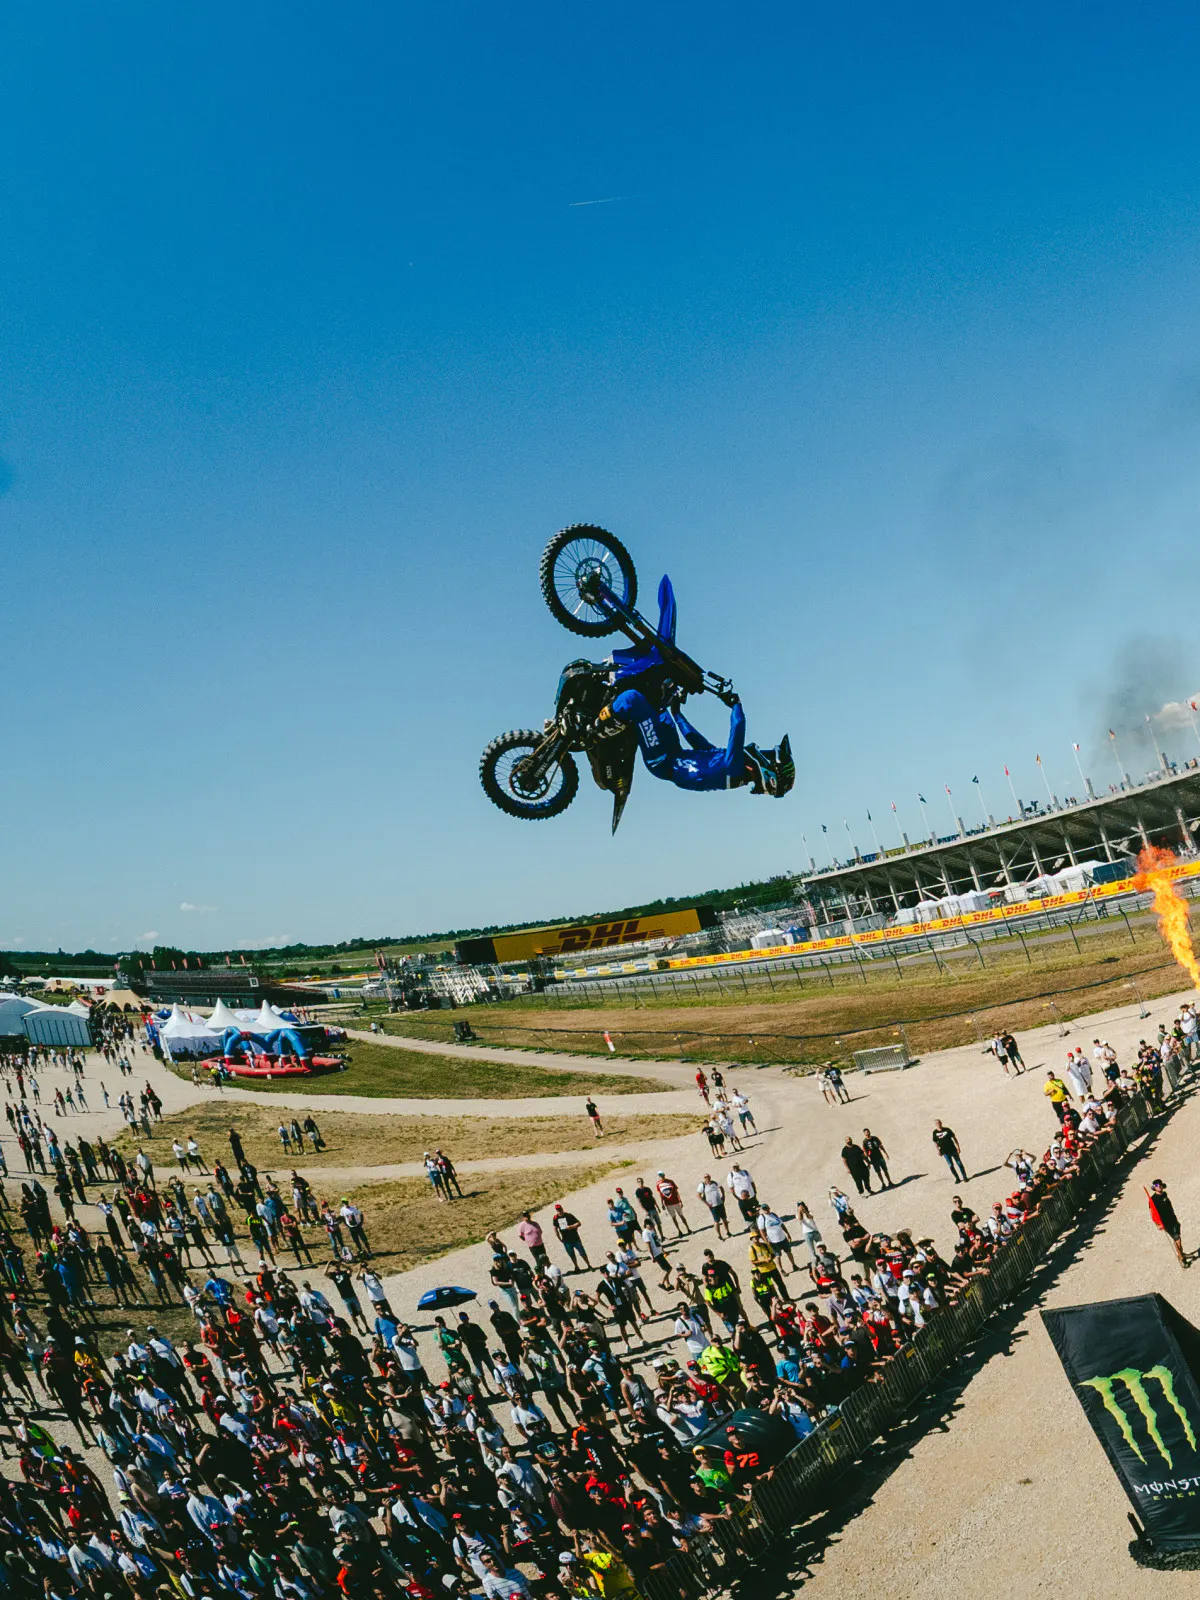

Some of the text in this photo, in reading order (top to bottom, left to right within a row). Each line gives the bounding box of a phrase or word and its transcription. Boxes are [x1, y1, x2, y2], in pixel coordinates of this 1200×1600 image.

[1040, 896, 1066, 908] DHL
[1005, 904, 1030, 915] DHL
[973, 911, 996, 921] DHL
[558, 920, 648, 952] DHL
[859, 933, 878, 941] DHL
[885, 928, 905, 937] DHL
[736, 1452, 761, 1468] 72
